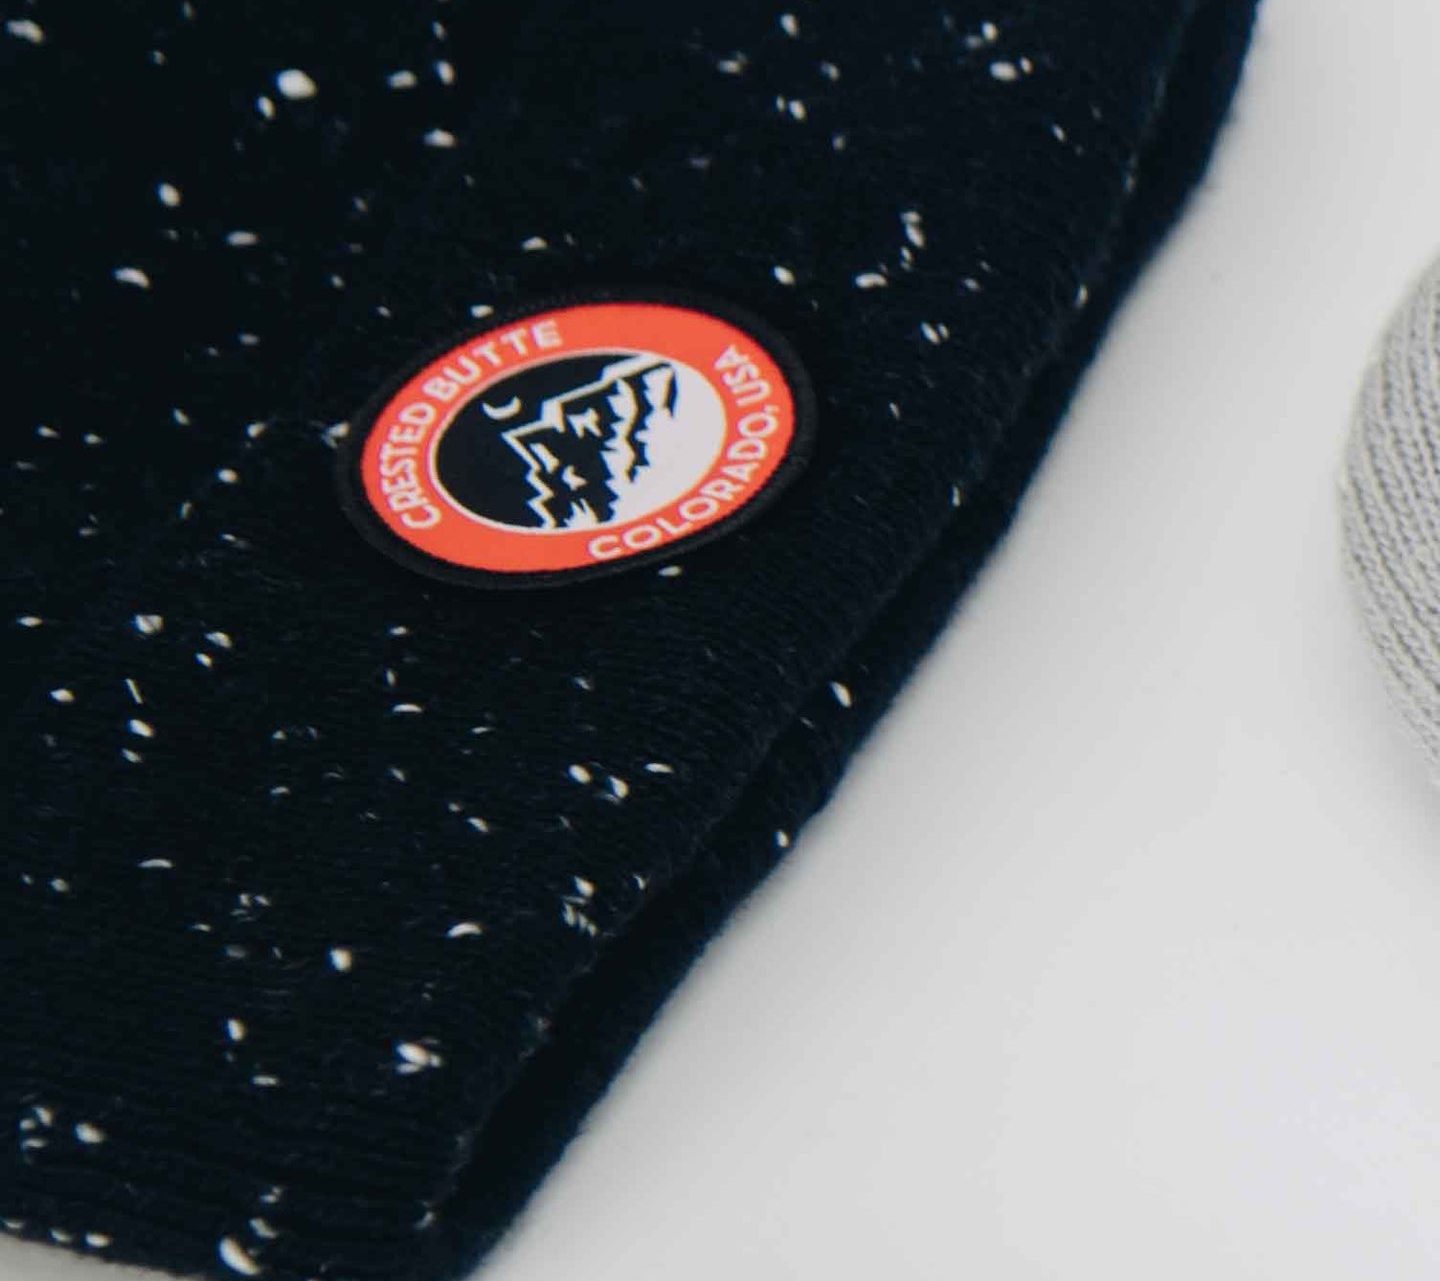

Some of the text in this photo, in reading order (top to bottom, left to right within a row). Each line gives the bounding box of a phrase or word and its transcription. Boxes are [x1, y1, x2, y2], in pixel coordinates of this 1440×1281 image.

[379, 320, 563, 530] CRESTED BUTTE
[587, 344, 780, 561] COLORADO, USA
